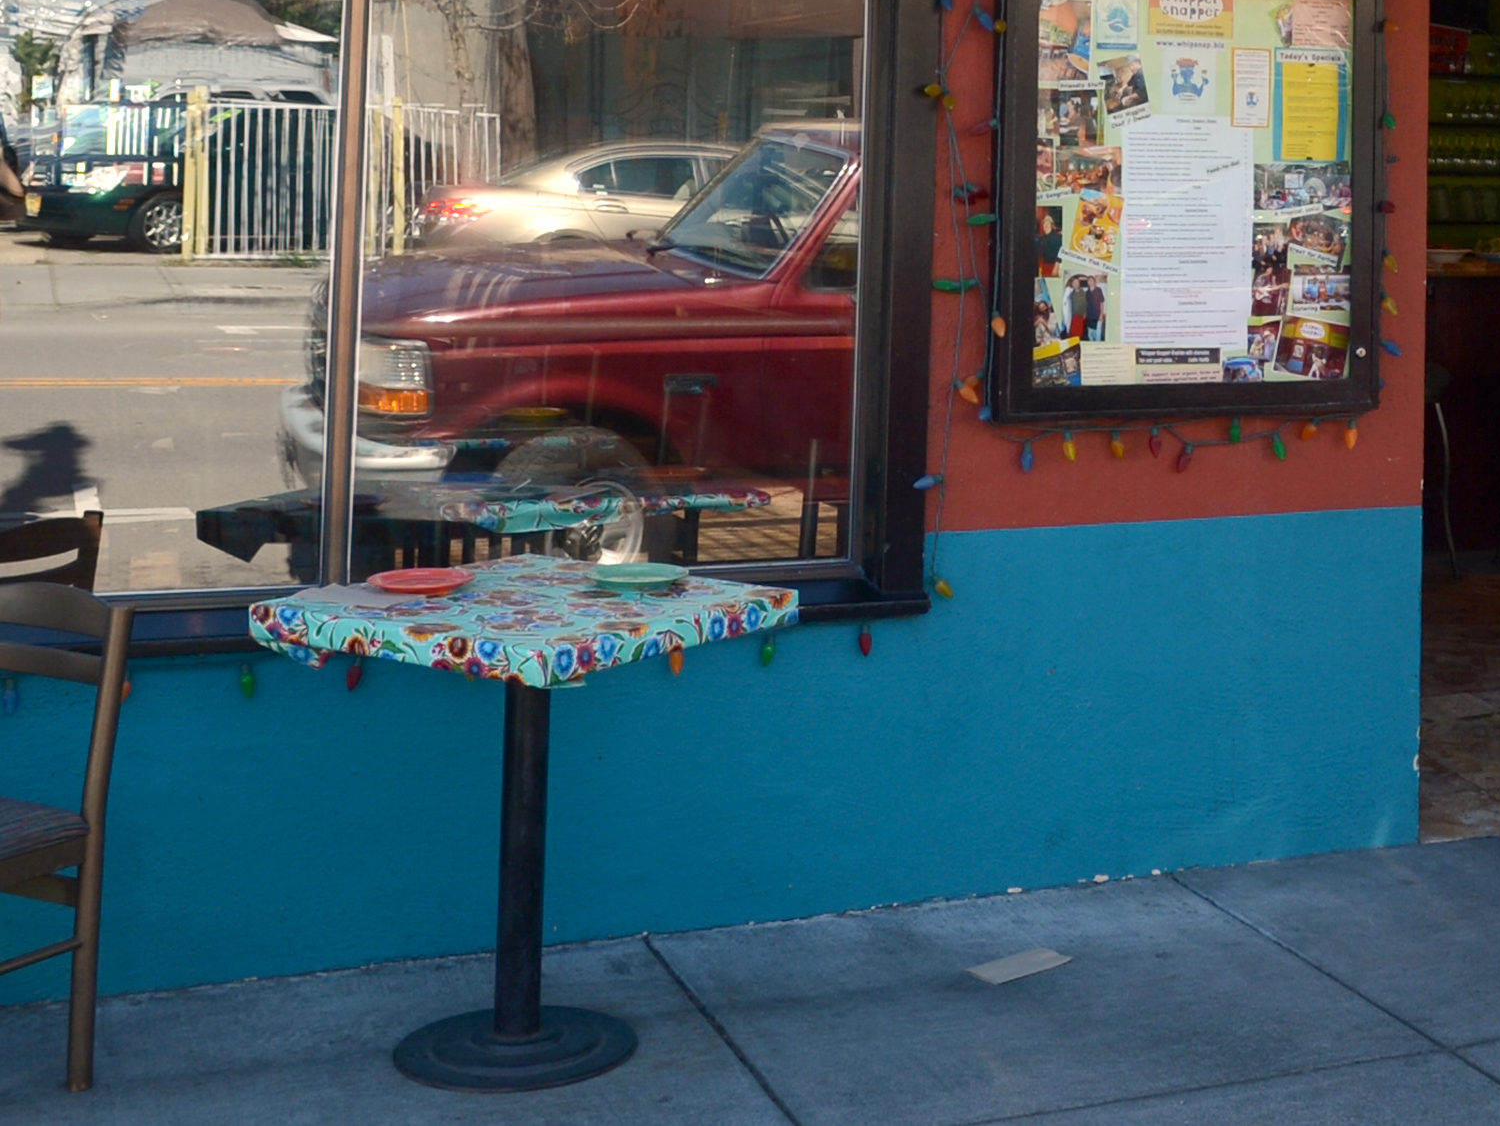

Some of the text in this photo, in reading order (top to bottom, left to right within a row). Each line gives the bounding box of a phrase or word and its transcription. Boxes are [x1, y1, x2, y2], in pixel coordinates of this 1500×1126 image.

[1163, 5, 1220, 20] snapper
[1280, 52, 1341, 62] Today's Specials
